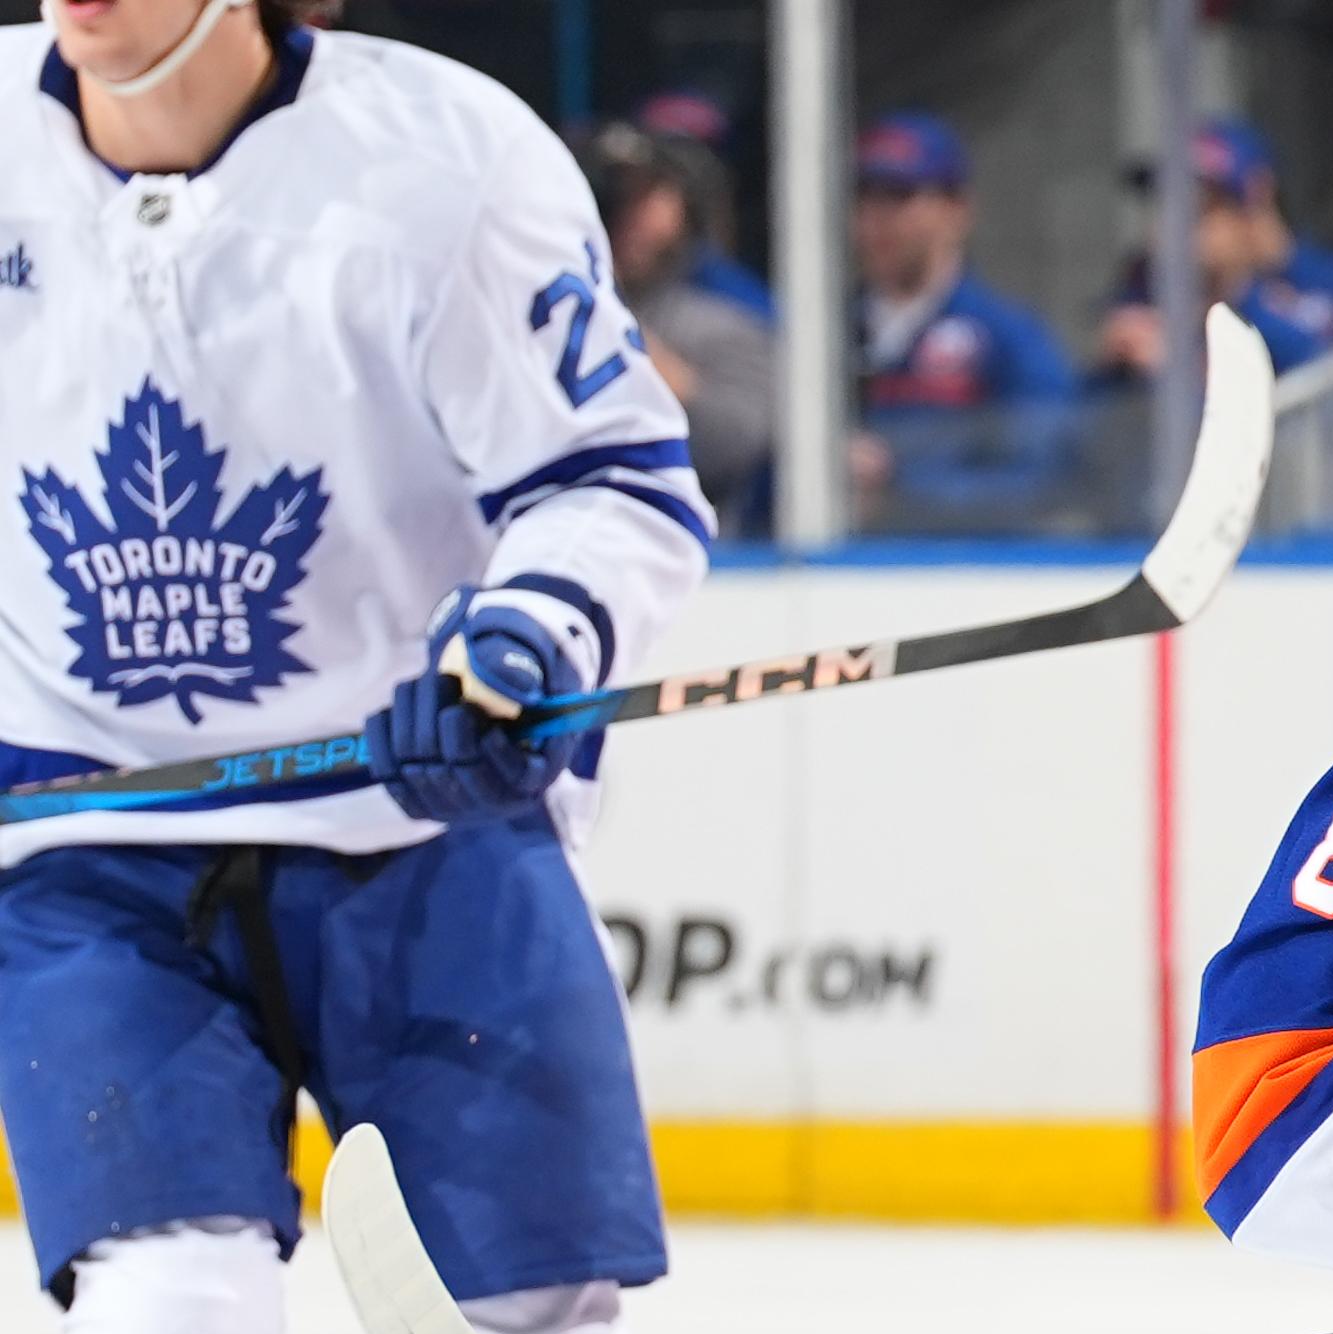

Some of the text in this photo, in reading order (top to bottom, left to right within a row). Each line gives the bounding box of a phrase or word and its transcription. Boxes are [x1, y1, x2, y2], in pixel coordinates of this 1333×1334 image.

[530, 240, 646, 409] 2
[64, 535, 278, 594] TORONTO
[101, 582, 249, 622] MAPLE
[105, 616, 252, 660] LEAFS
[658, 641, 899, 716] CCM
